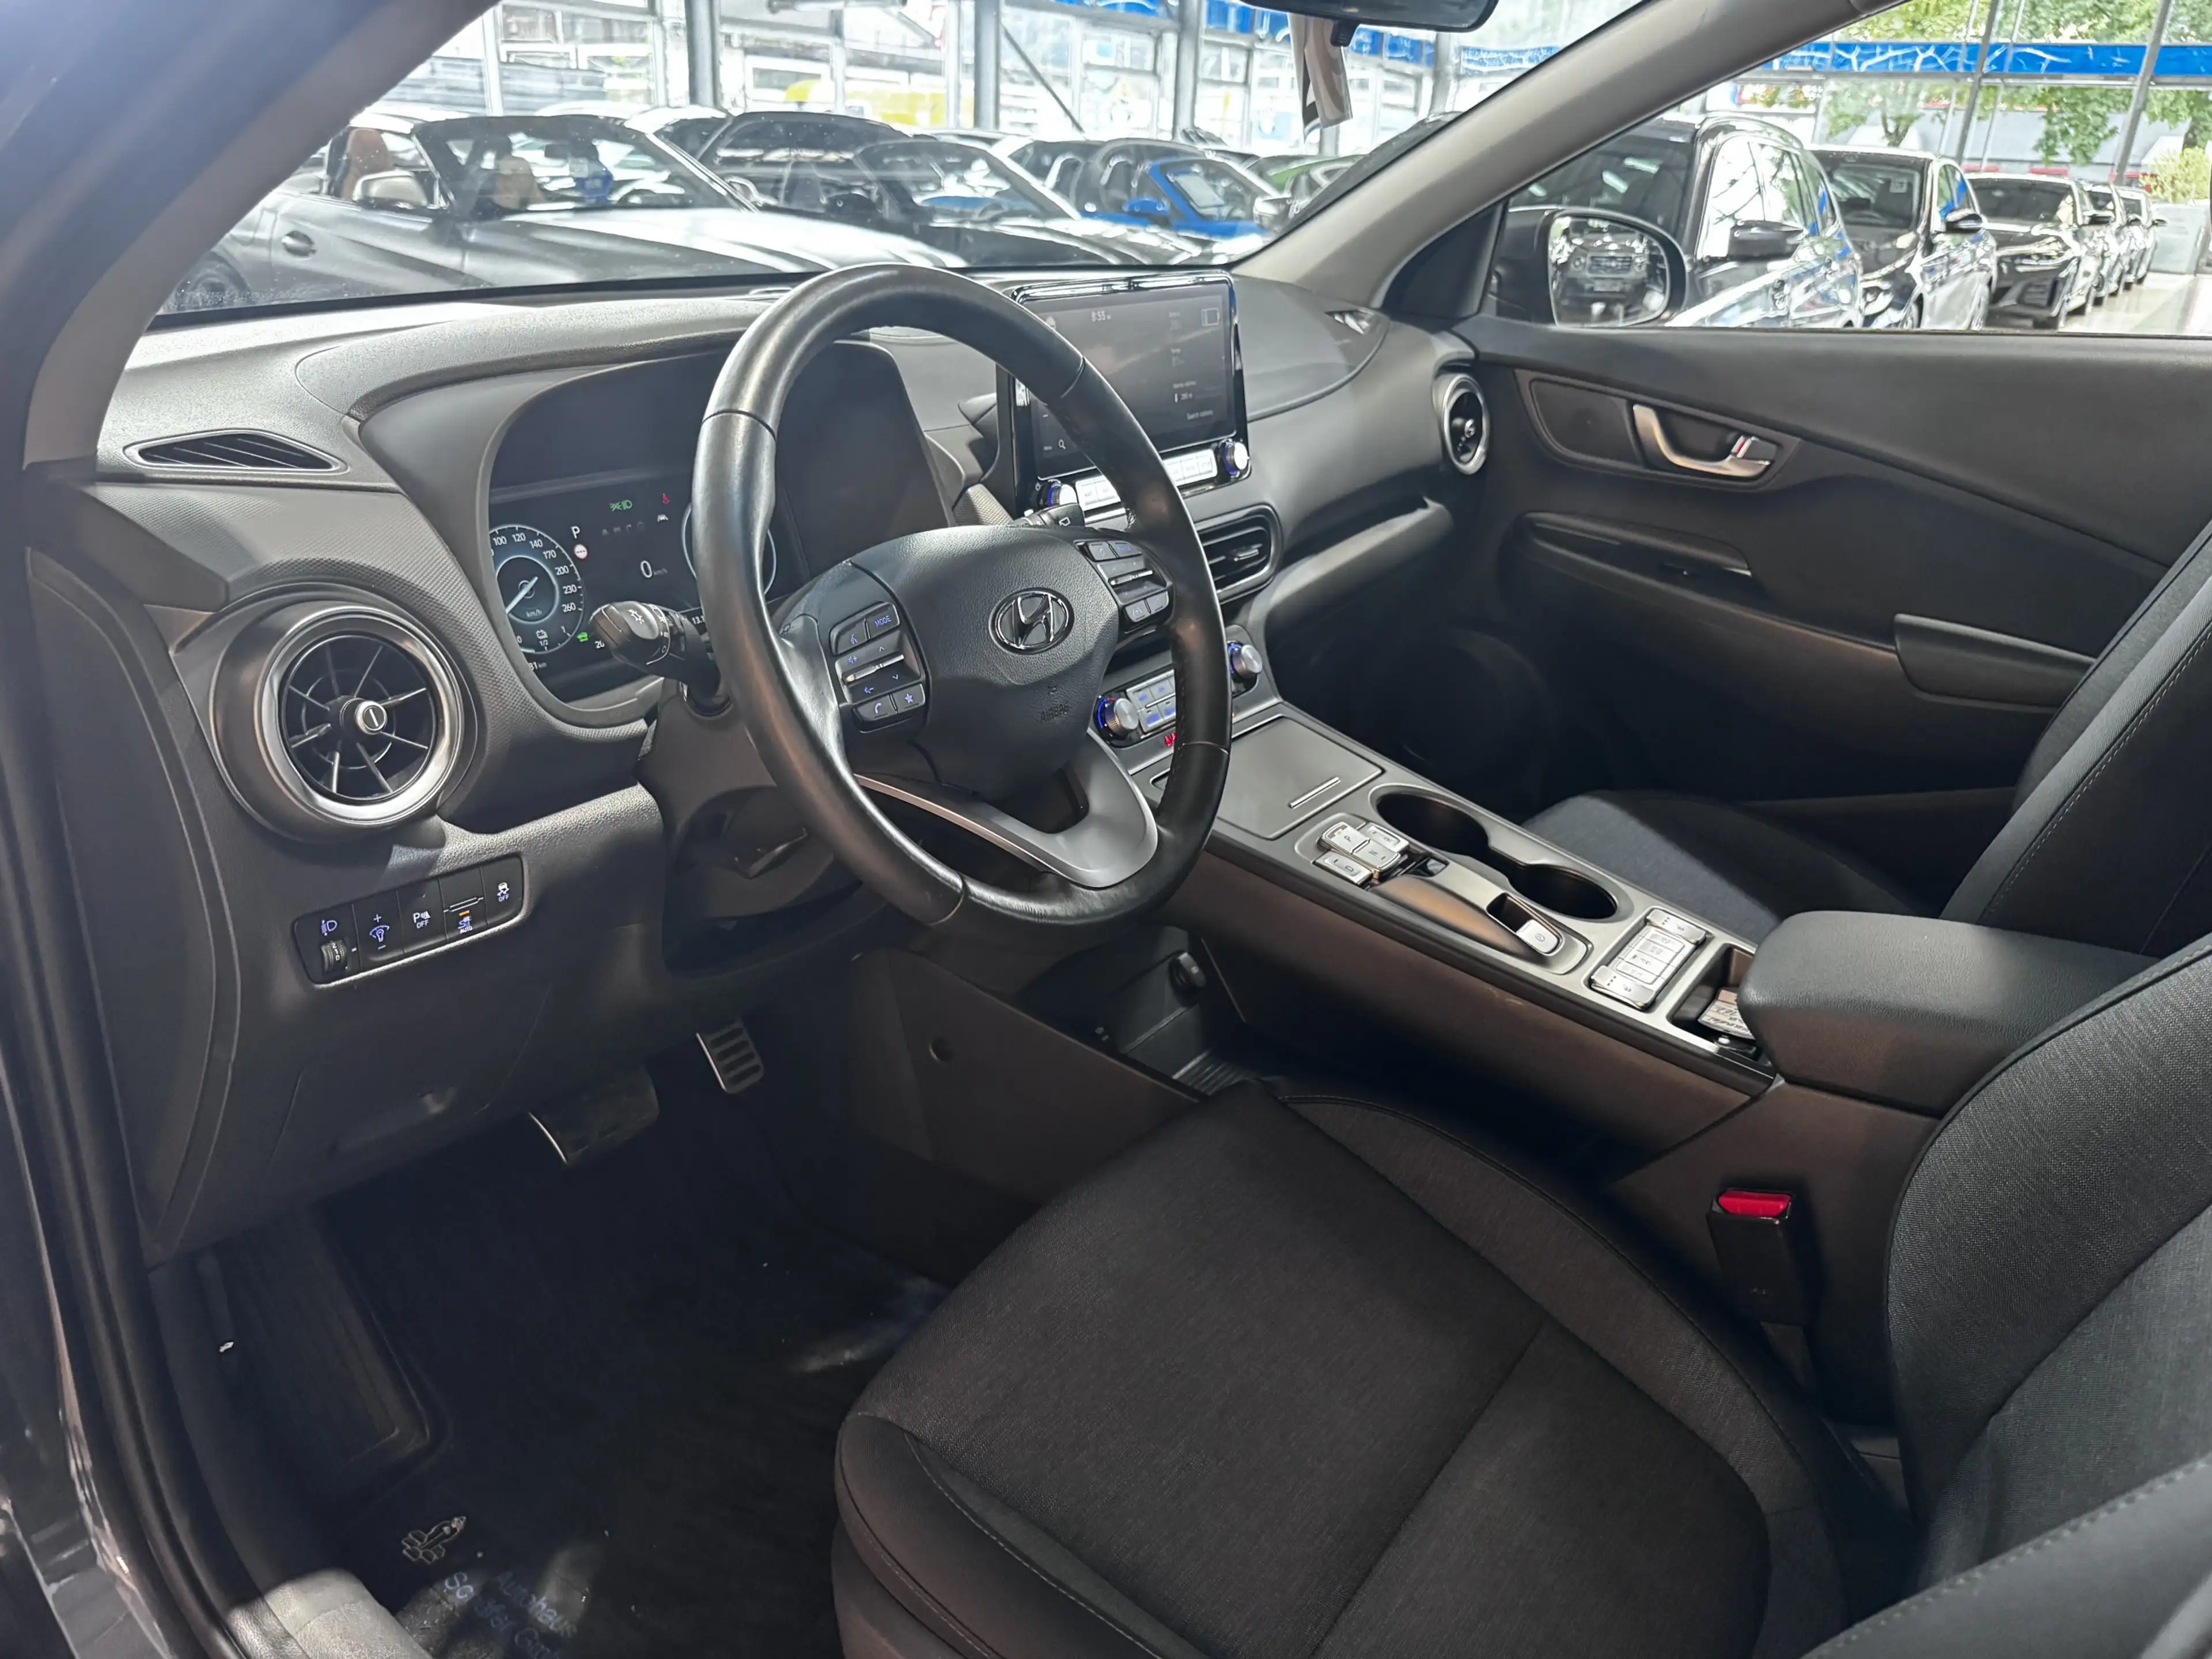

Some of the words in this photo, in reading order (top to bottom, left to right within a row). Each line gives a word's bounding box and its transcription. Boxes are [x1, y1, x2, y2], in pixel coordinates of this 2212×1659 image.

[571, 526, 581, 539] P
[493, 536, 507, 546] 100
[512, 533, 526, 543] 120
[529, 539, 543, 549] 140
[543, 550, 556, 559] 170
[555, 565, 569, 575] 200
[640, 560, 653, 578] 0
[562, 585, 577, 594] 230
[562, 603, 576, 612] 260
[874, 615, 892, 627] MODE
[416, 919, 429, 929] OFF
